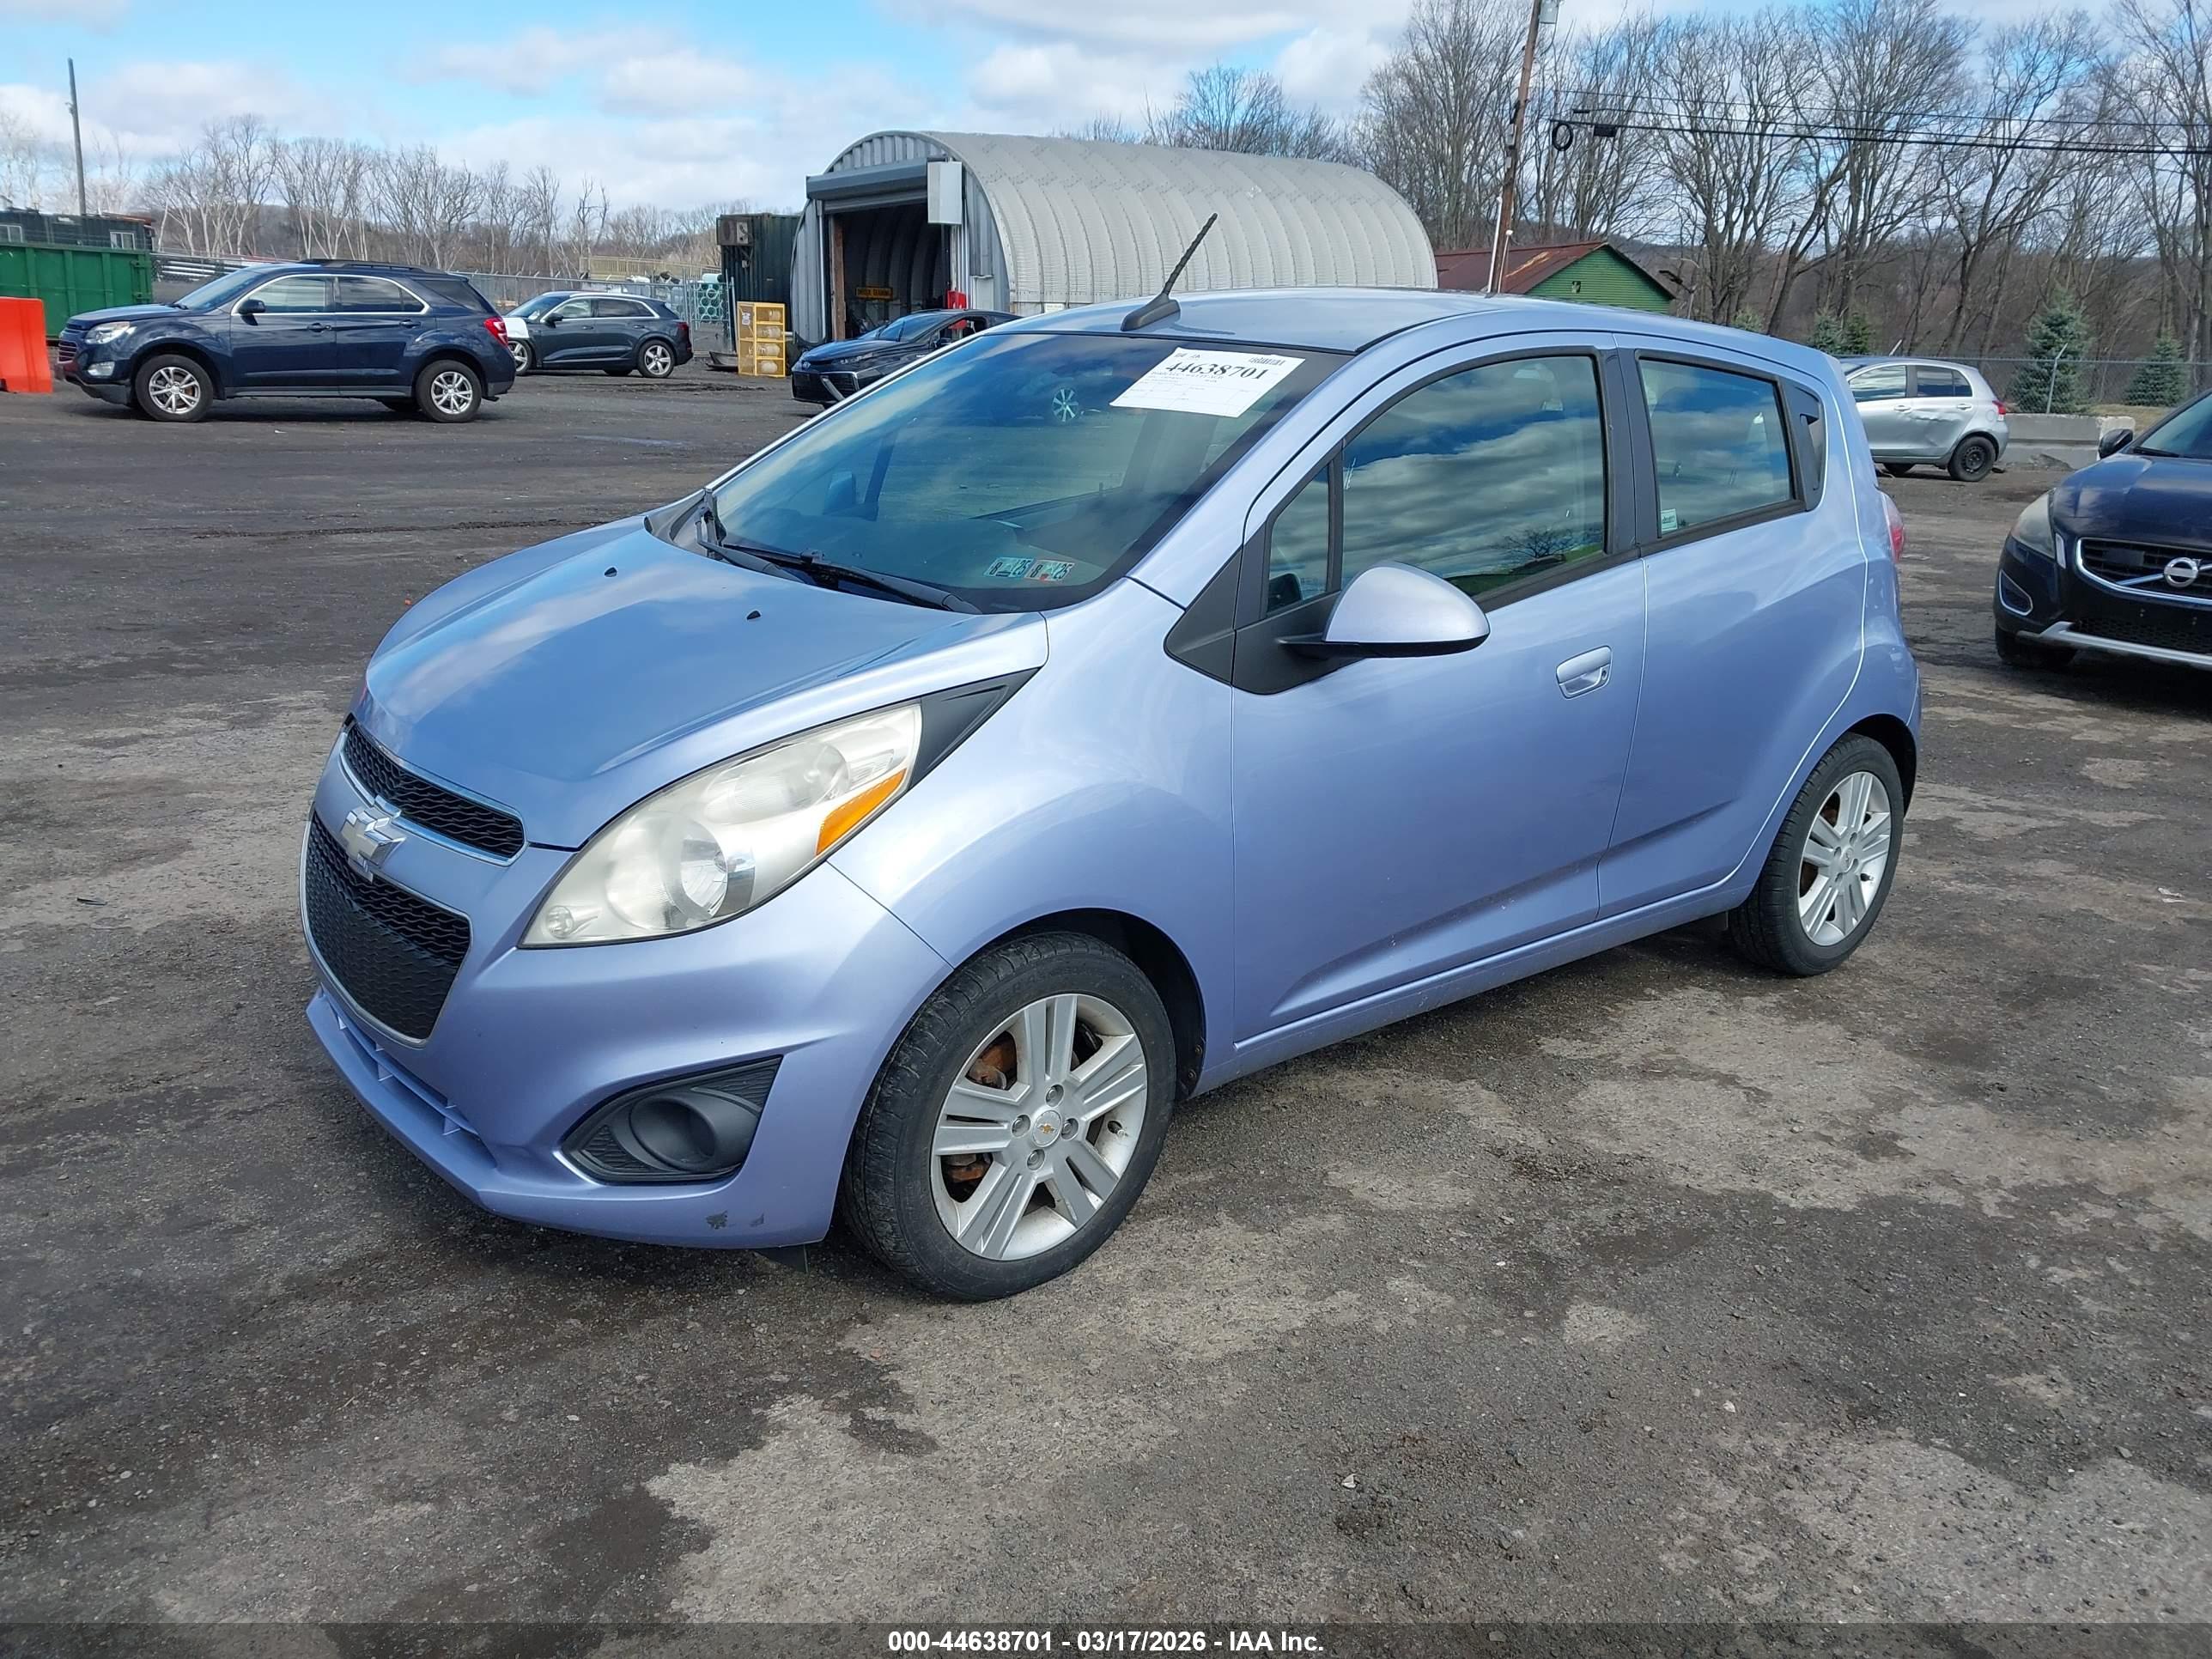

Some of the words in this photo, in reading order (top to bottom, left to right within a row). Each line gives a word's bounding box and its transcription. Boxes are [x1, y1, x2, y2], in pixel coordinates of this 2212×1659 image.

[1165, 362, 1269, 380] 44638701
[989, 562, 1004, 575] 8
[1030, 564, 1043, 578] 8
